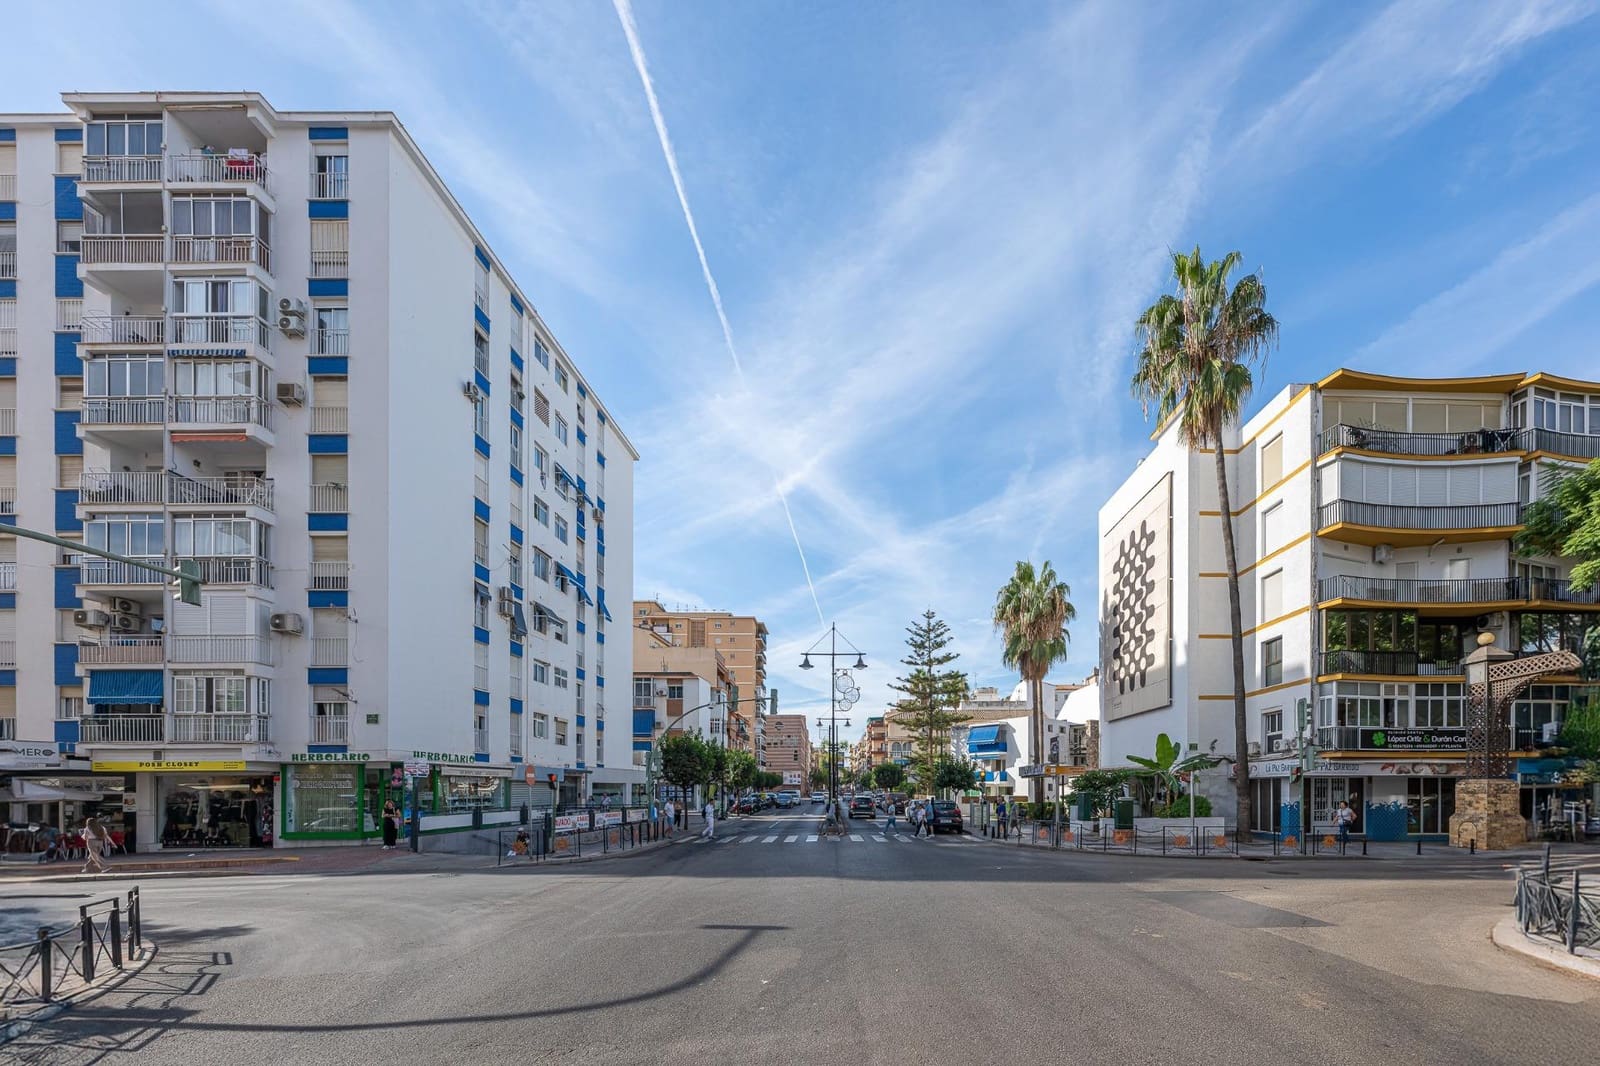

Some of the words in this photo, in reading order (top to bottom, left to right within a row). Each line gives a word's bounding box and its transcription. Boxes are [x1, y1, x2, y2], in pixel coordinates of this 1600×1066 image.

[1423, 735, 1430, 743] &
[292, 753, 370, 761] HERBOLARIO
[413, 751, 475, 763] HERBOLARIO
